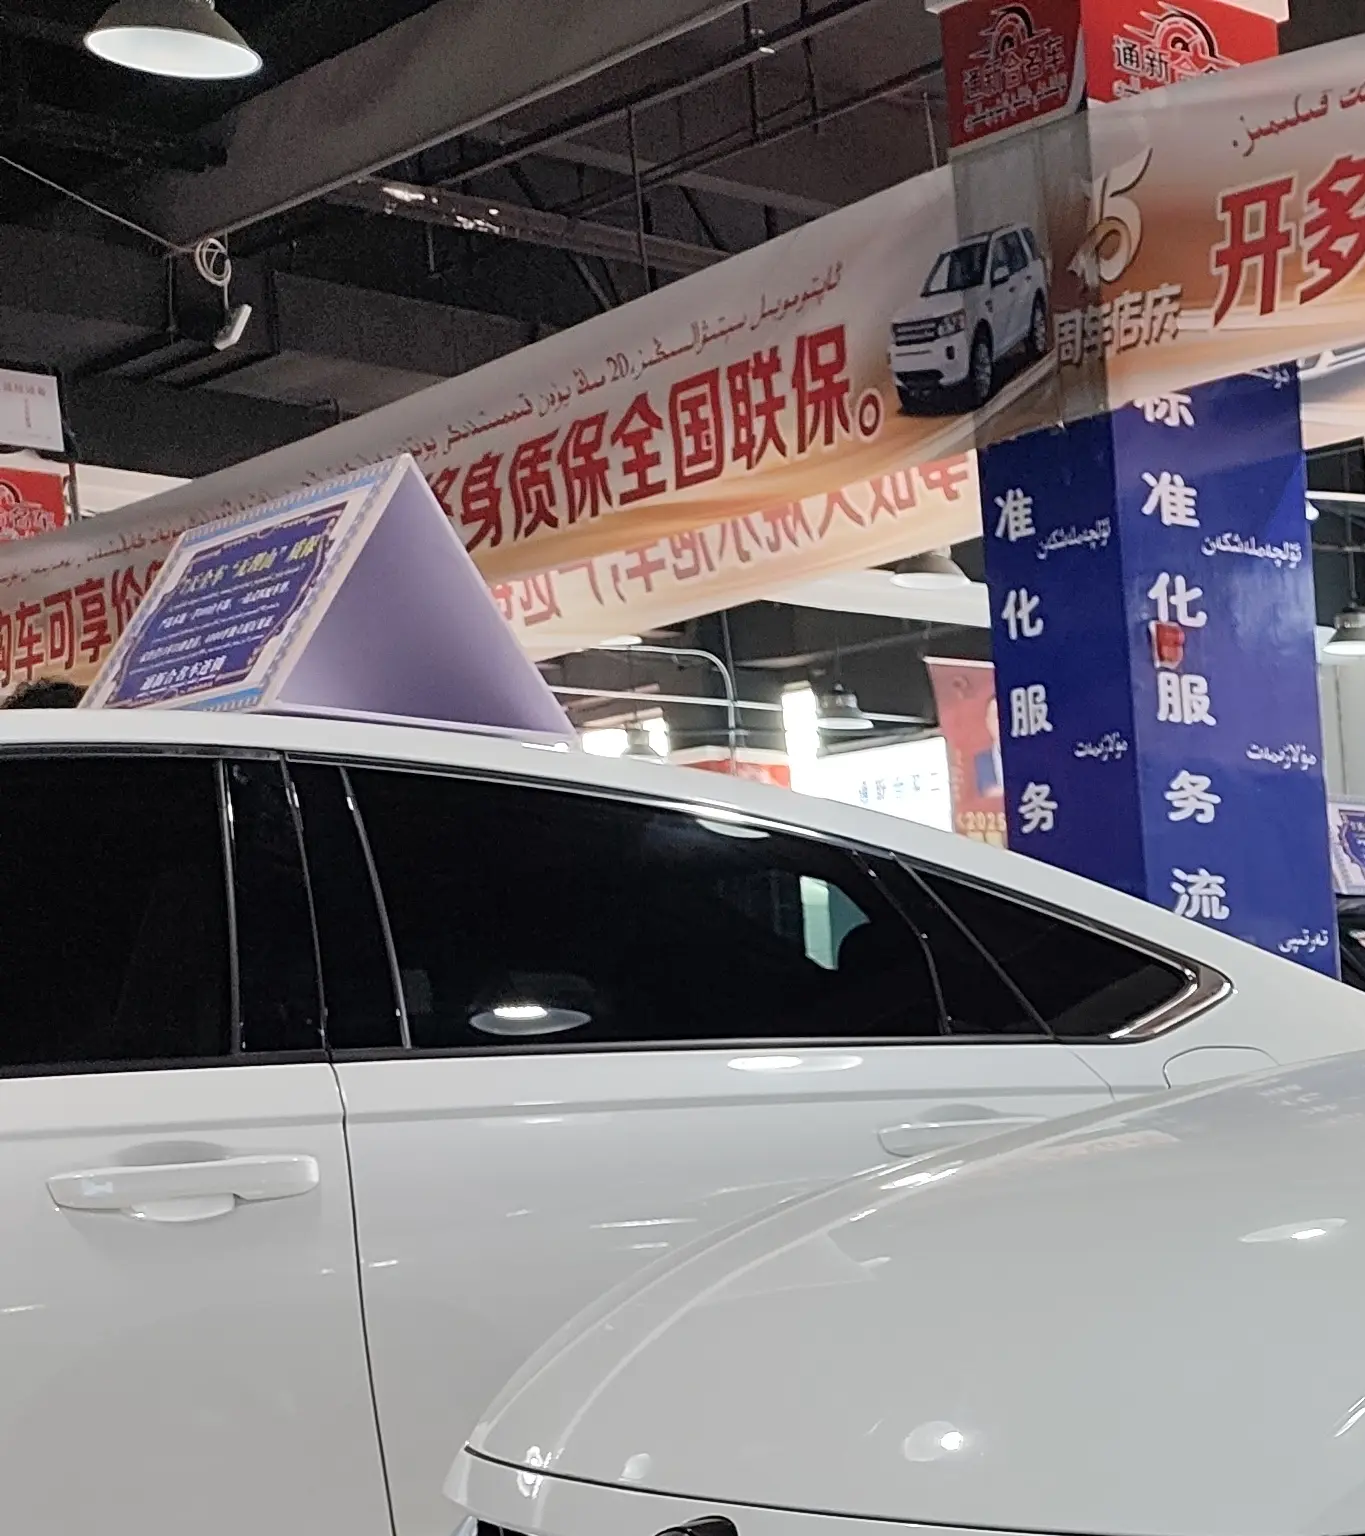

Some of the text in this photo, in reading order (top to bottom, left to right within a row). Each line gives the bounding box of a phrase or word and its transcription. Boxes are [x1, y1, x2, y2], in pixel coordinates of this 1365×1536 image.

[0, 560, 165, 689] 车可享价
[994, 487, 1058, 834] 准化服务
